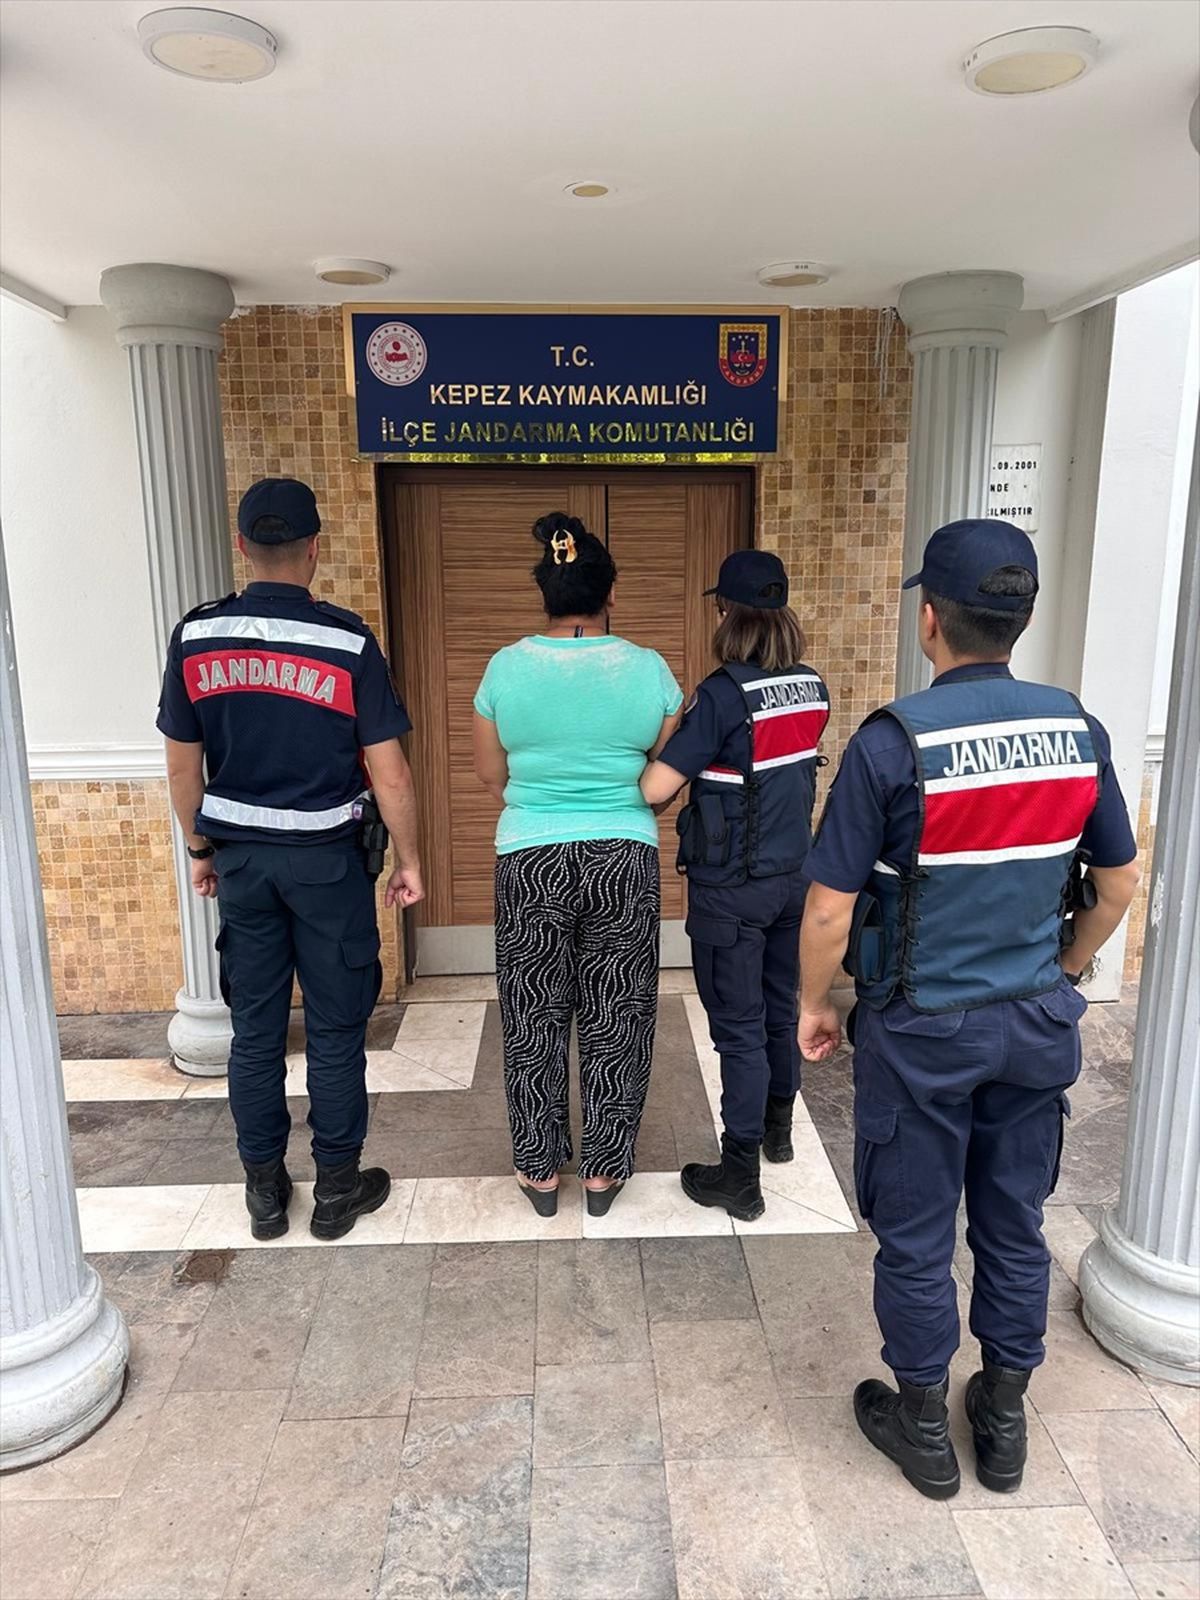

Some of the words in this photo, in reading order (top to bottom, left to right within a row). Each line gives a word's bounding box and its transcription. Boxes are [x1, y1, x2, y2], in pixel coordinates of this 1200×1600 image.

[551, 346, 594, 367] T.C.
[430, 384, 511, 405] KEPEZ
[518, 380, 707, 405] KAYMAKAMLIĞI
[382, 417, 437, 447] İLÇE
[444, 421, 582, 443] JANDARMA
[589, 417, 755, 443] KOMUTANLIĞI
[197, 658, 336, 704] JANDARMA
[760, 682, 821, 710] JANDARMA
[943, 731, 1081, 777] JANDARMA
